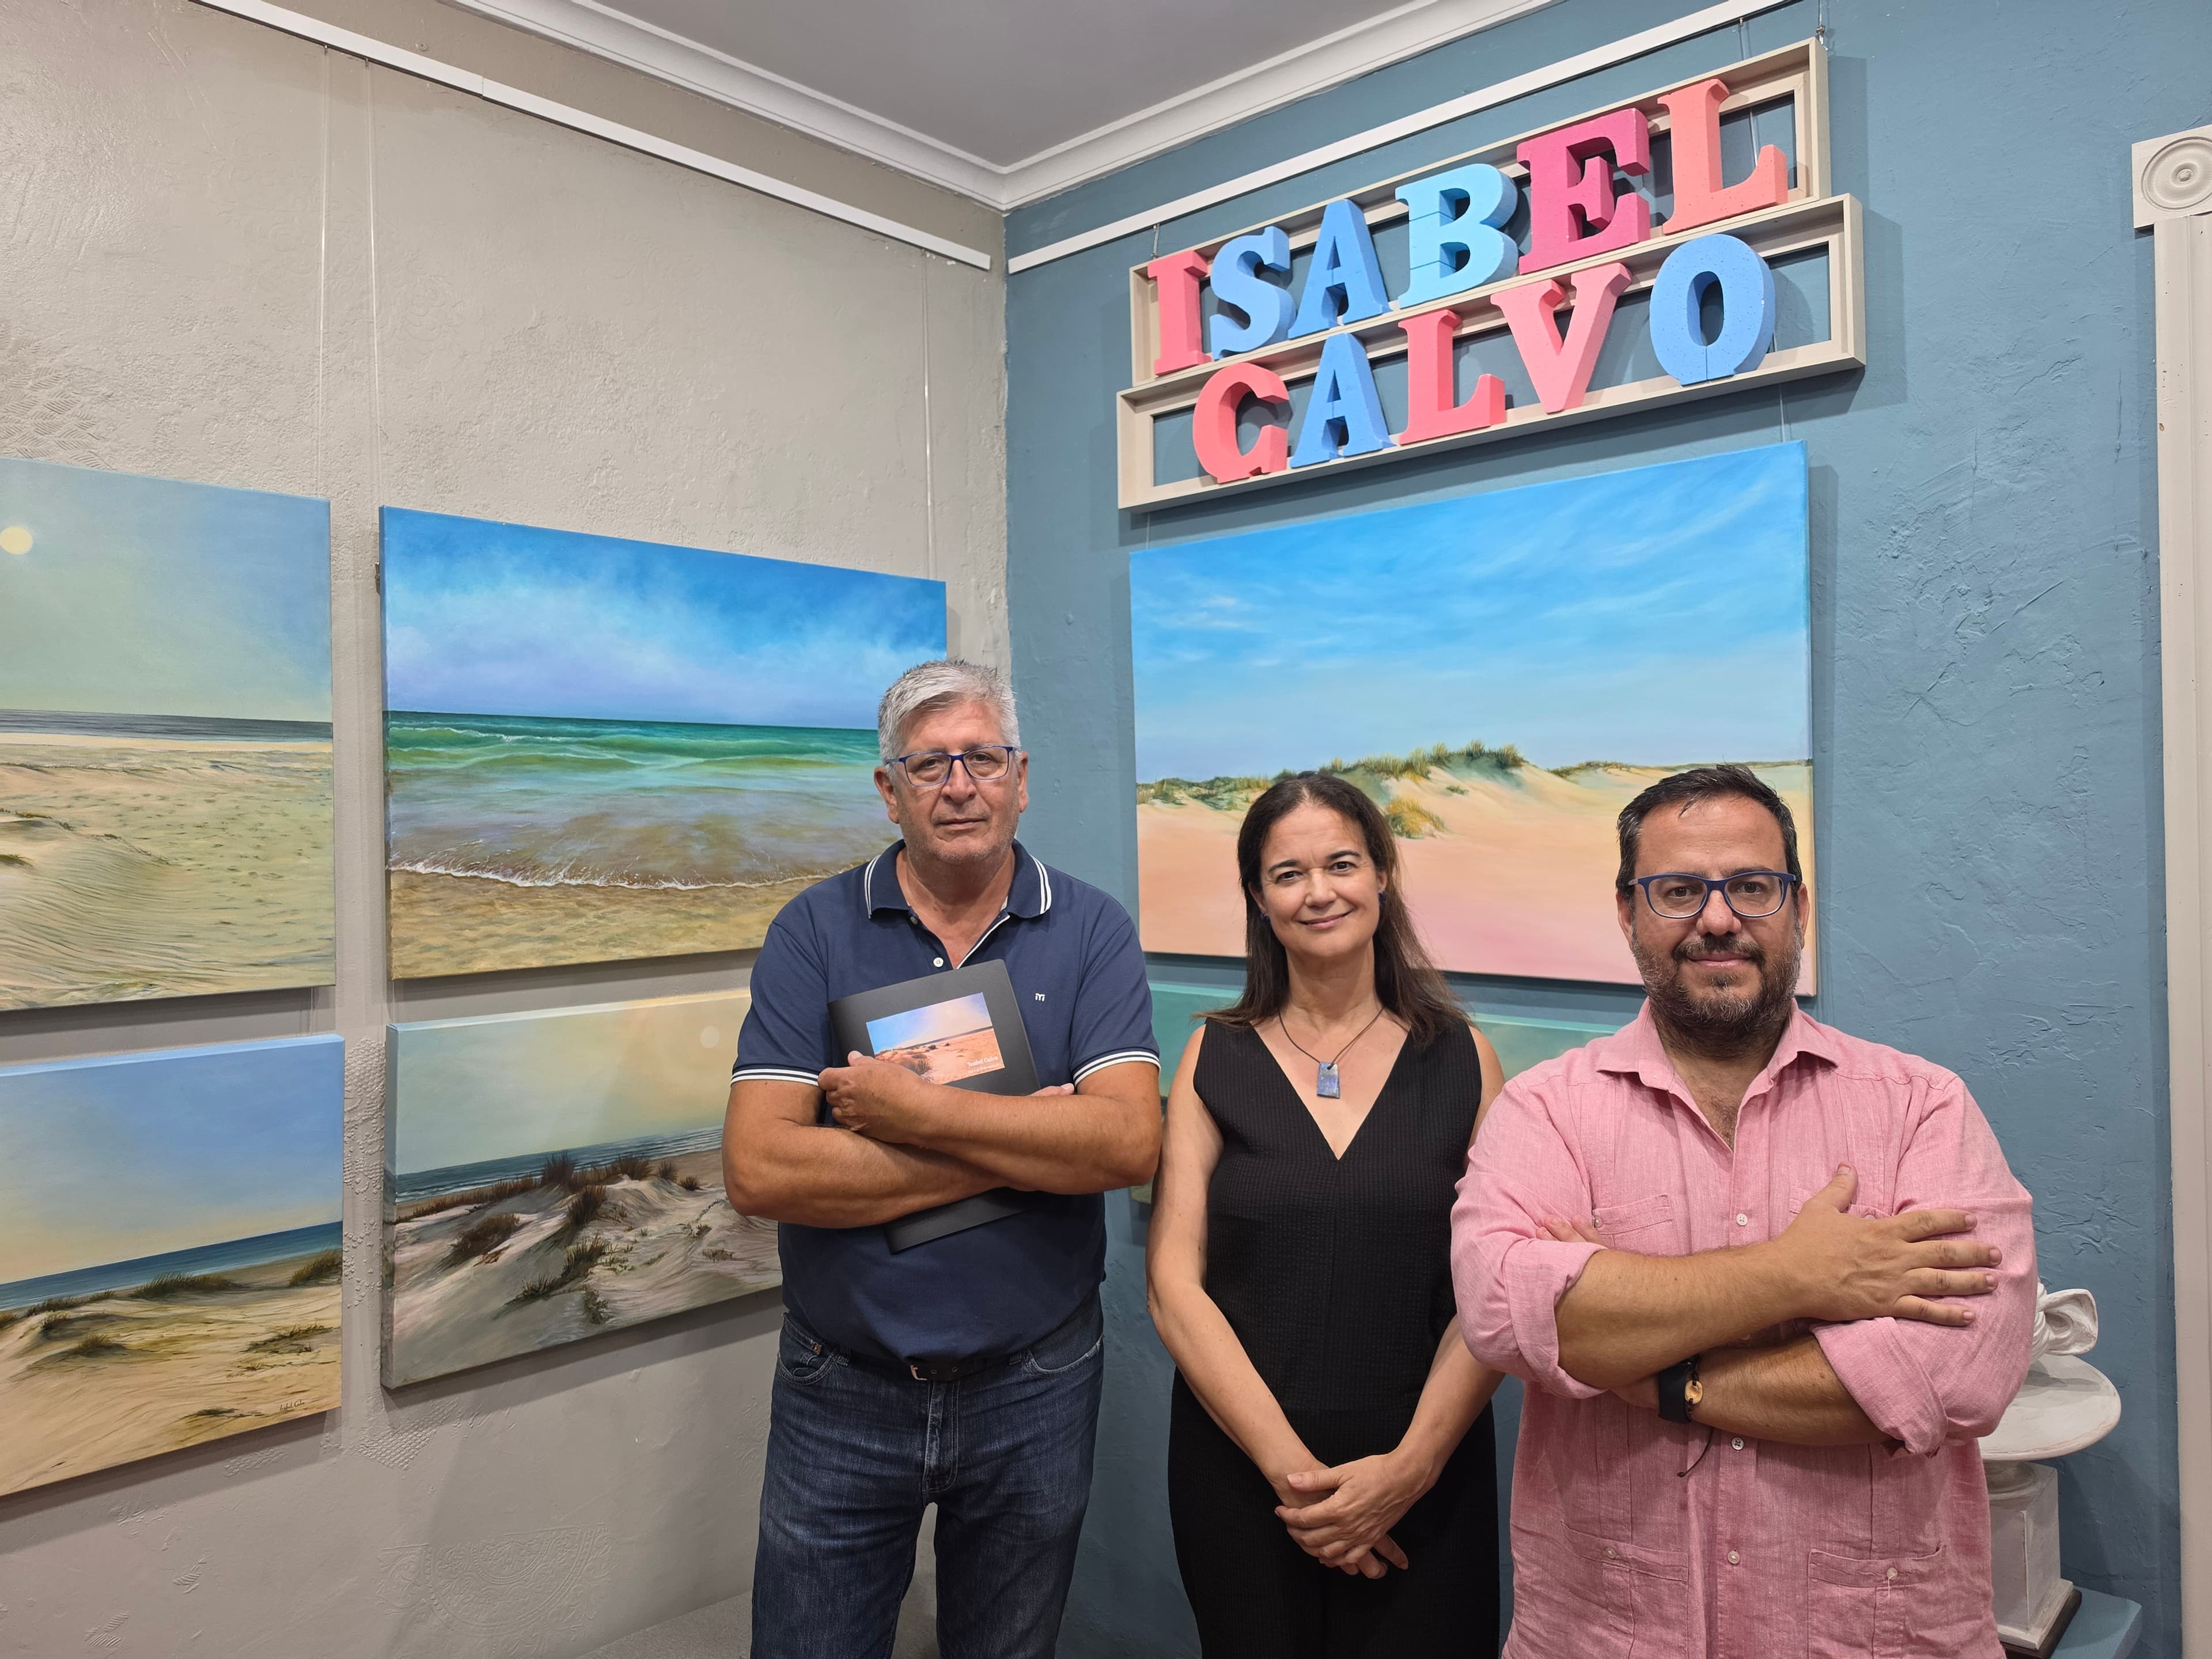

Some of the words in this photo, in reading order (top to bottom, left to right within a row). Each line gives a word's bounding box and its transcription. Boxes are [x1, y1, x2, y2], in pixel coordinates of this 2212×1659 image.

[1147, 78, 1788, 376] ISABEL
[1192, 233, 1776, 484] CALVO
[967, 1058, 983, 1067] Isabel
[984, 1055, 998, 1063] Calvo
